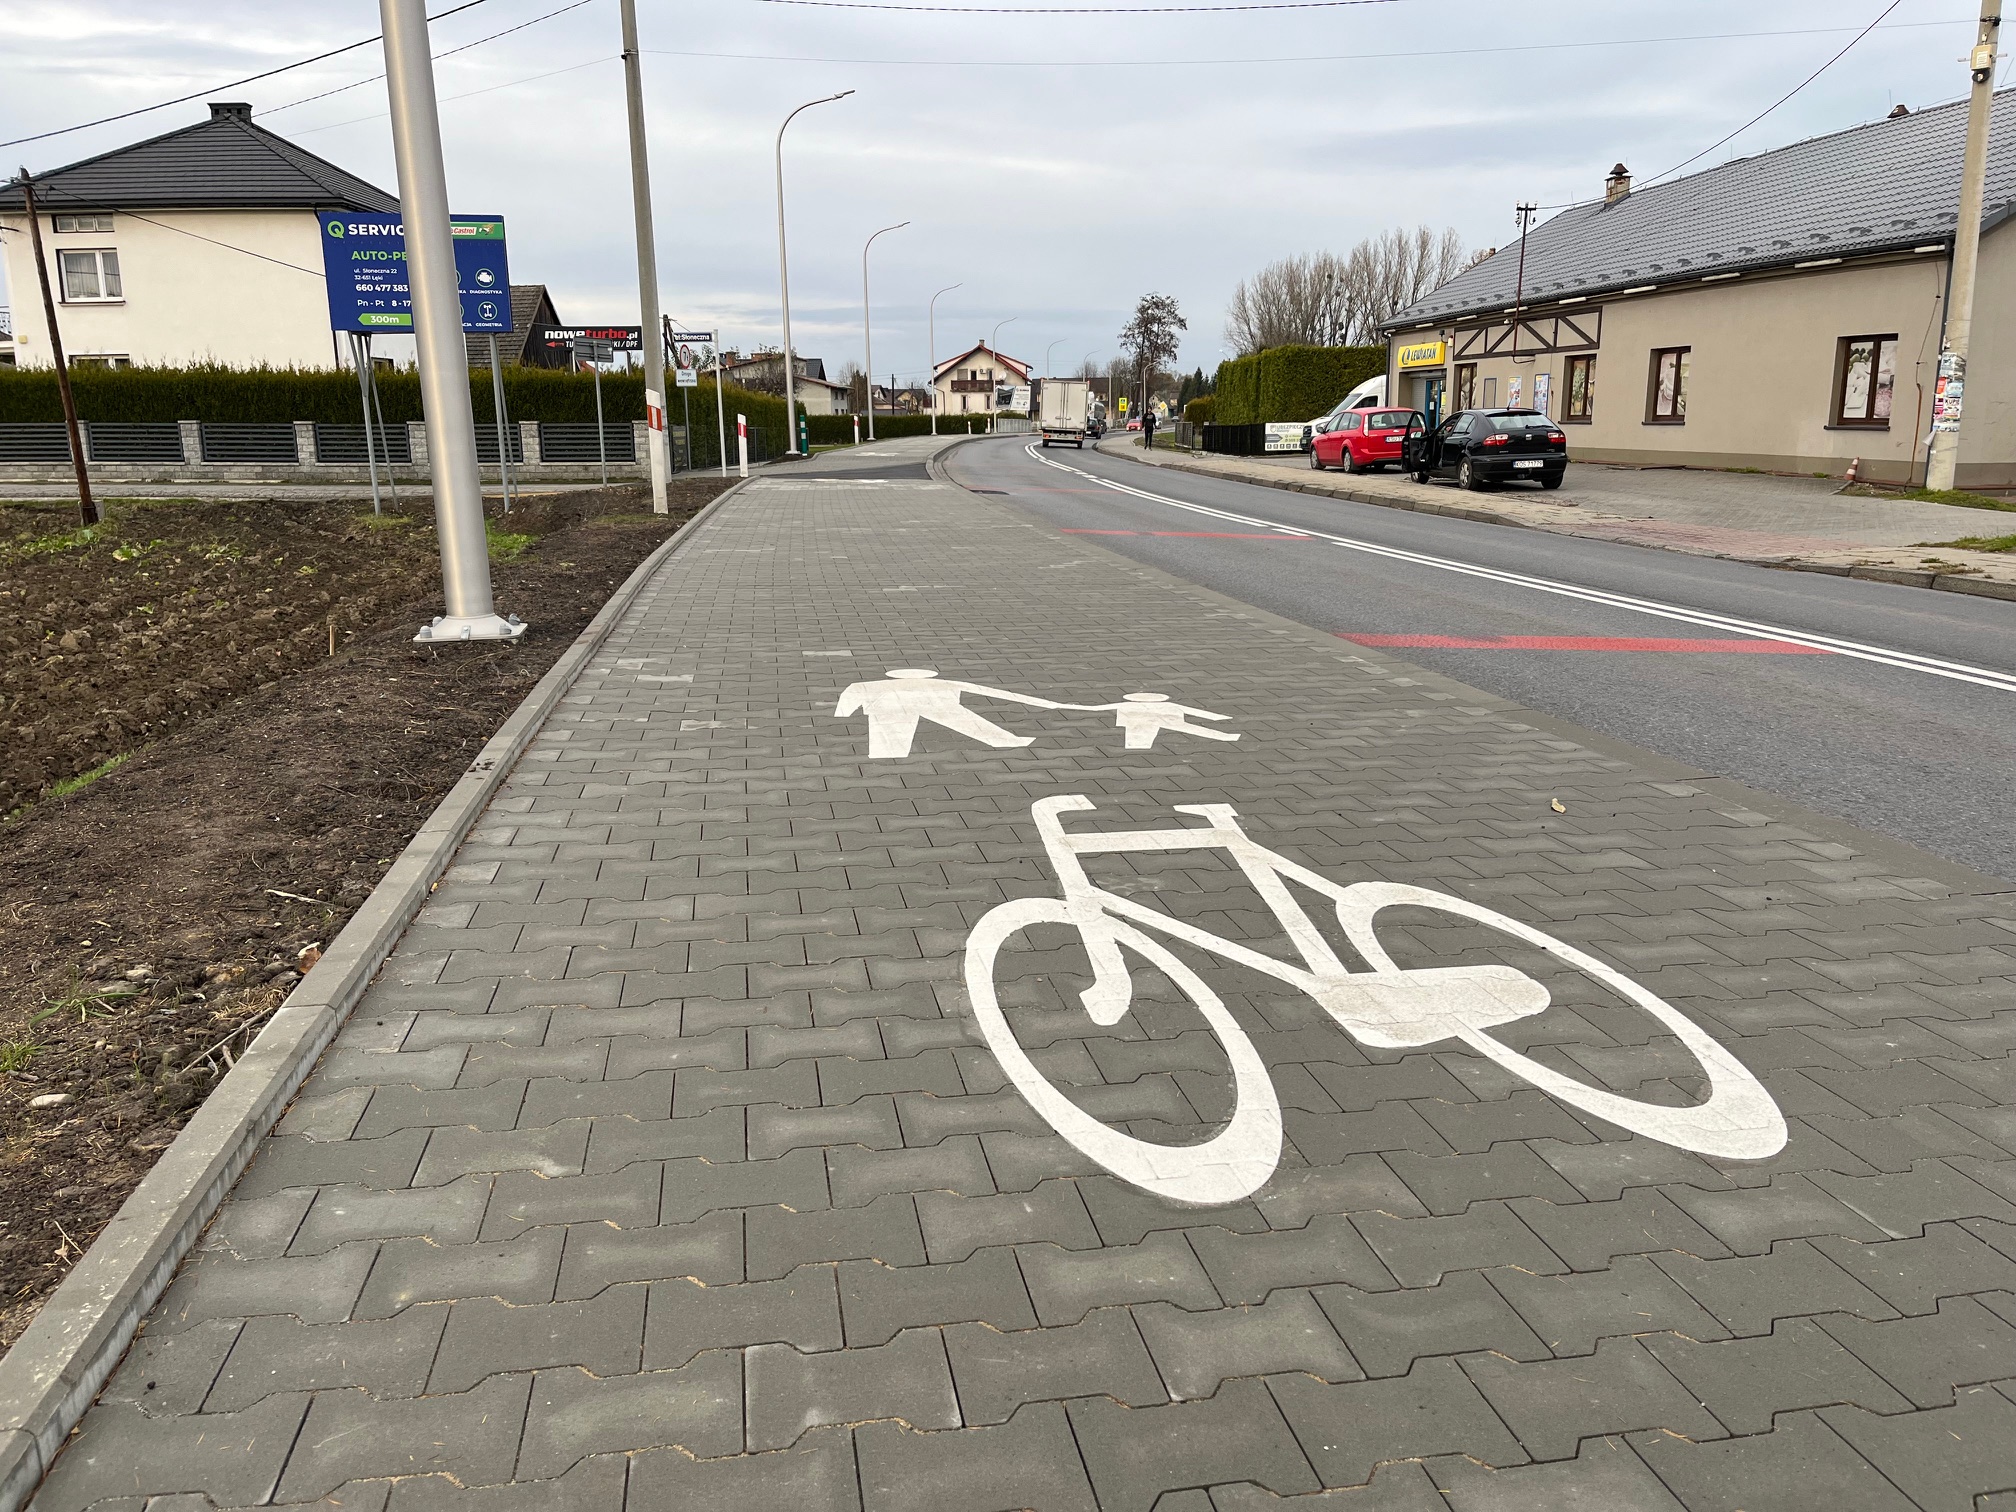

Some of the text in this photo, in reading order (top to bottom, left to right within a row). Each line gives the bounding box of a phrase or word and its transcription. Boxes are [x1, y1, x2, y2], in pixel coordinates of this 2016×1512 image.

[355, 284, 409, 292] 660 477 383
[357, 299, 369, 307] Pn
[370, 315, 400, 324] 300m
[544, 328, 639, 340] noweturbo.pl
[1410, 347, 1437, 362] LEWIATAN
